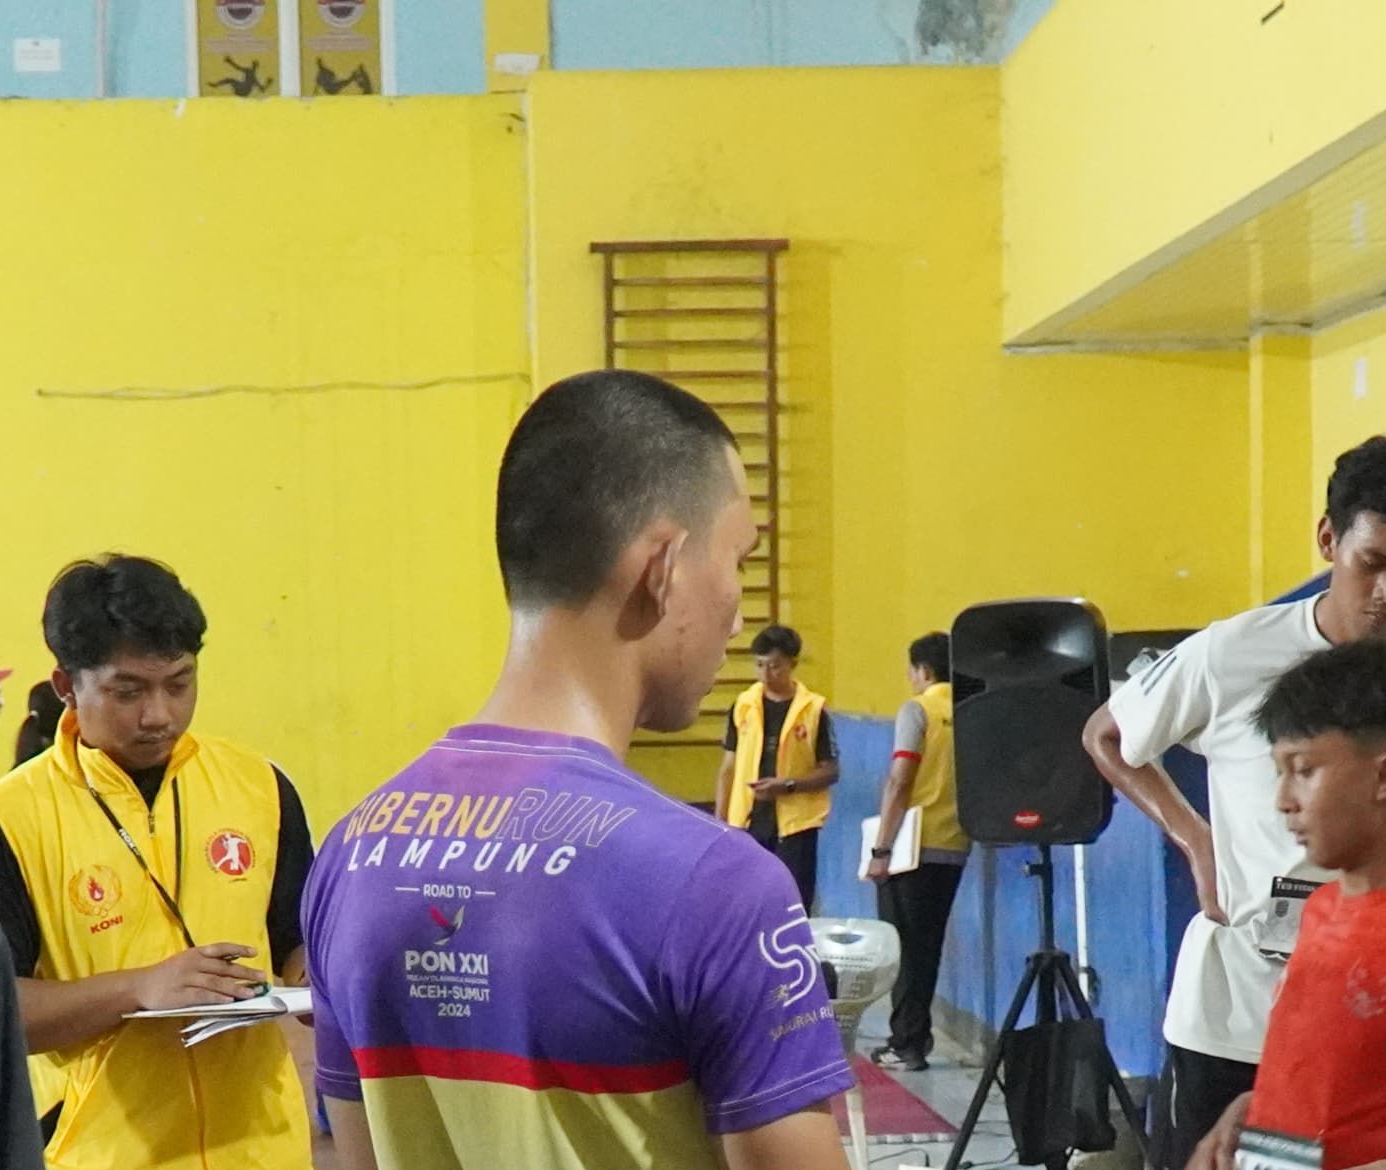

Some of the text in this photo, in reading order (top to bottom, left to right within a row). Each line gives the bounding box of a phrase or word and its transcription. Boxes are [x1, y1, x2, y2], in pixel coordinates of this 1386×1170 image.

[347, 836, 577, 875] LAMPUNG
[423, 884, 471, 898] ROAD TO
[90, 915, 123, 934] KONI
[405, 950, 488, 975] PON XXI
[409, 984, 490, 1002] ACEH-SUMUT
[438, 1003, 471, 1017] 2024
